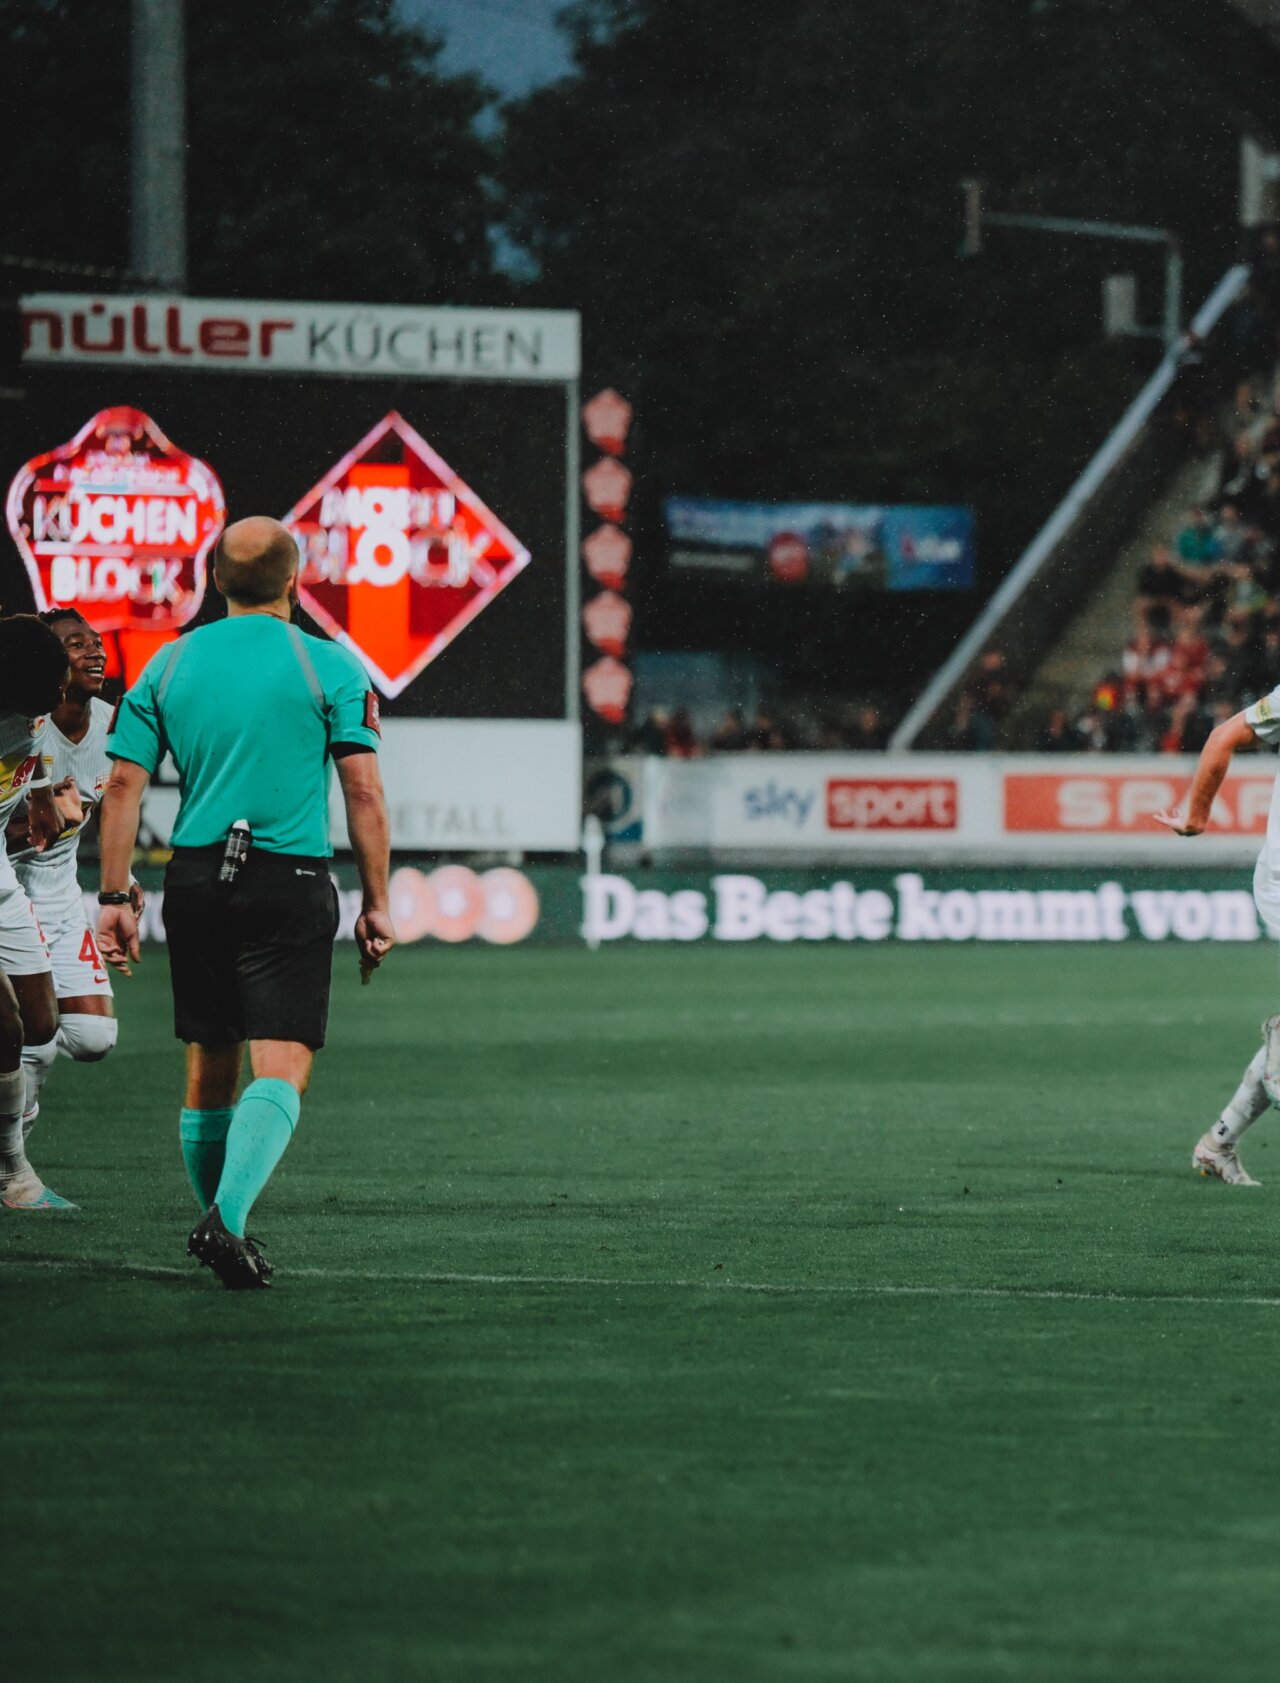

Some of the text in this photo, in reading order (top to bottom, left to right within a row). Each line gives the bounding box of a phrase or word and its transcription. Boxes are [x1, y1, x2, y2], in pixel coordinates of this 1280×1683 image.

[307, 309, 544, 369] KÜCHEN
[51, 556, 183, 602] BLOCK
[744, 781, 953, 834] sky sport
[581, 872, 1259, 941] Das Beste kommt von
[79, 929, 106, 970] 4
